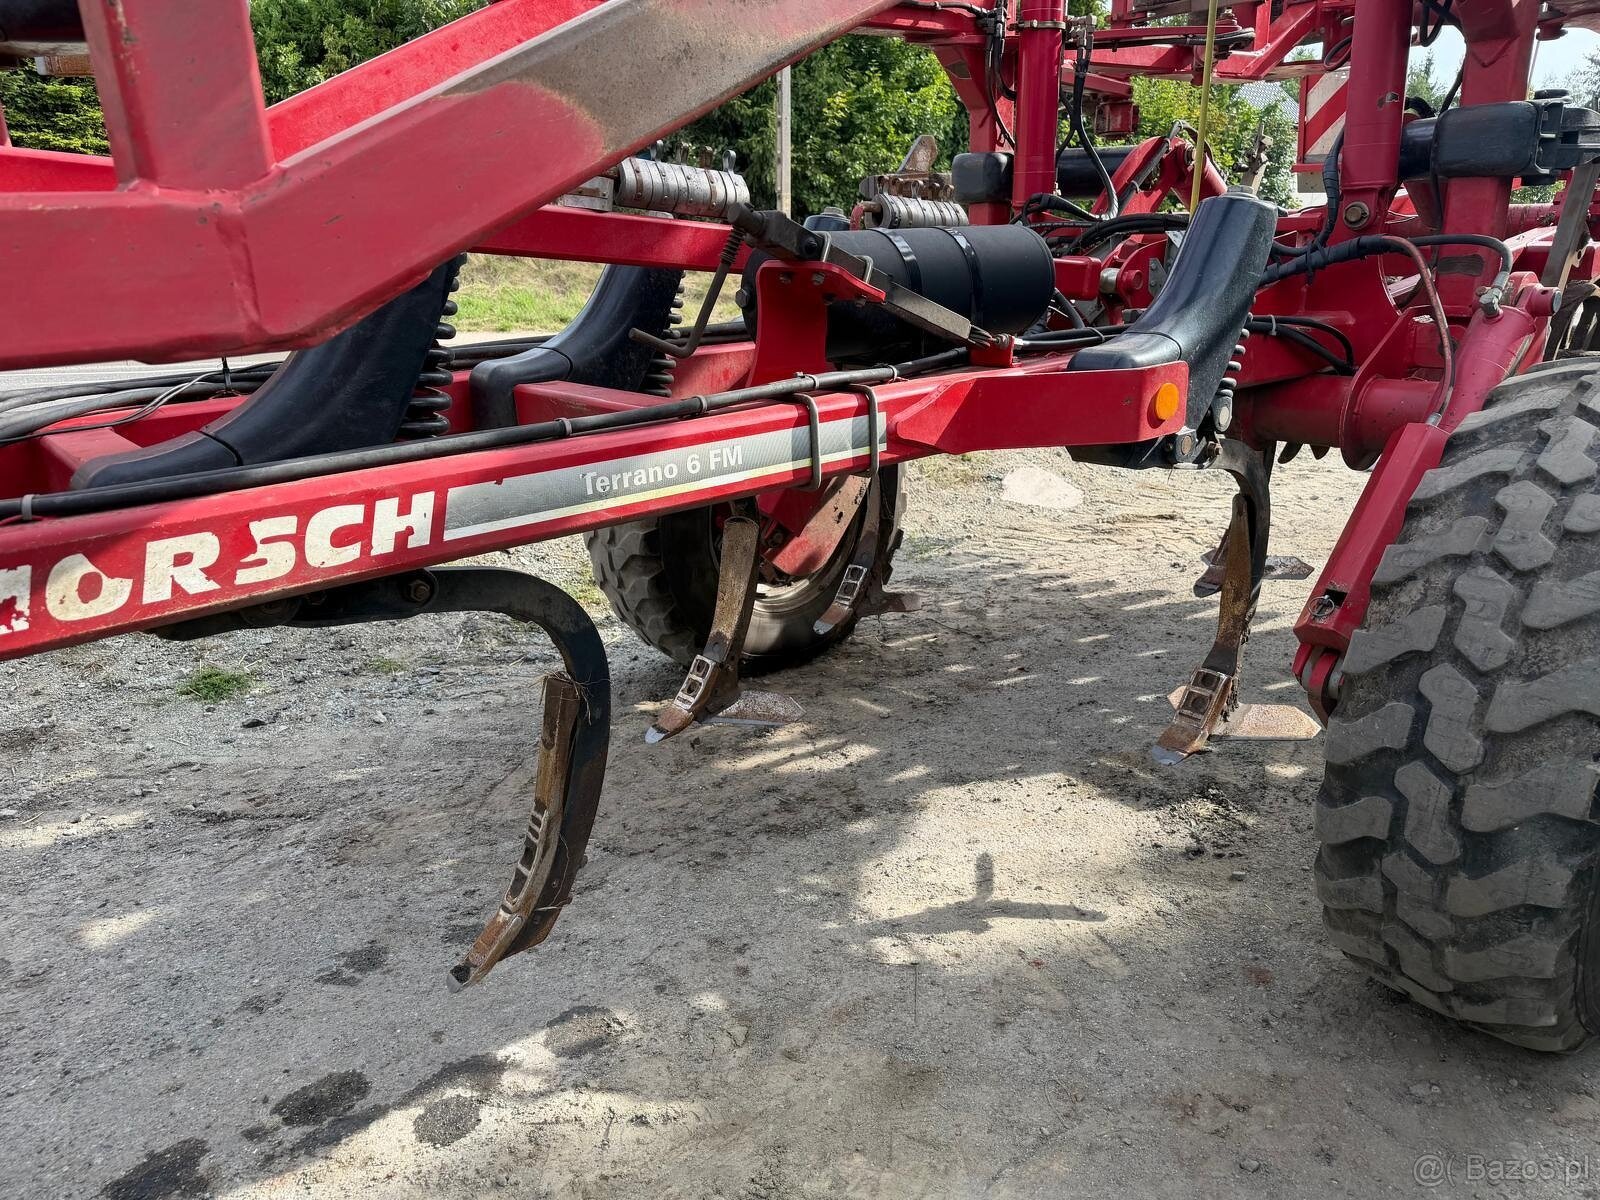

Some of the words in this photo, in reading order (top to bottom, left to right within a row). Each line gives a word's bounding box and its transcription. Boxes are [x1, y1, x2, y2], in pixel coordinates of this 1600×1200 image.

[580, 462, 679, 496] Terrano
[686, 453, 701, 475] 6
[708, 445, 743, 471] FM
